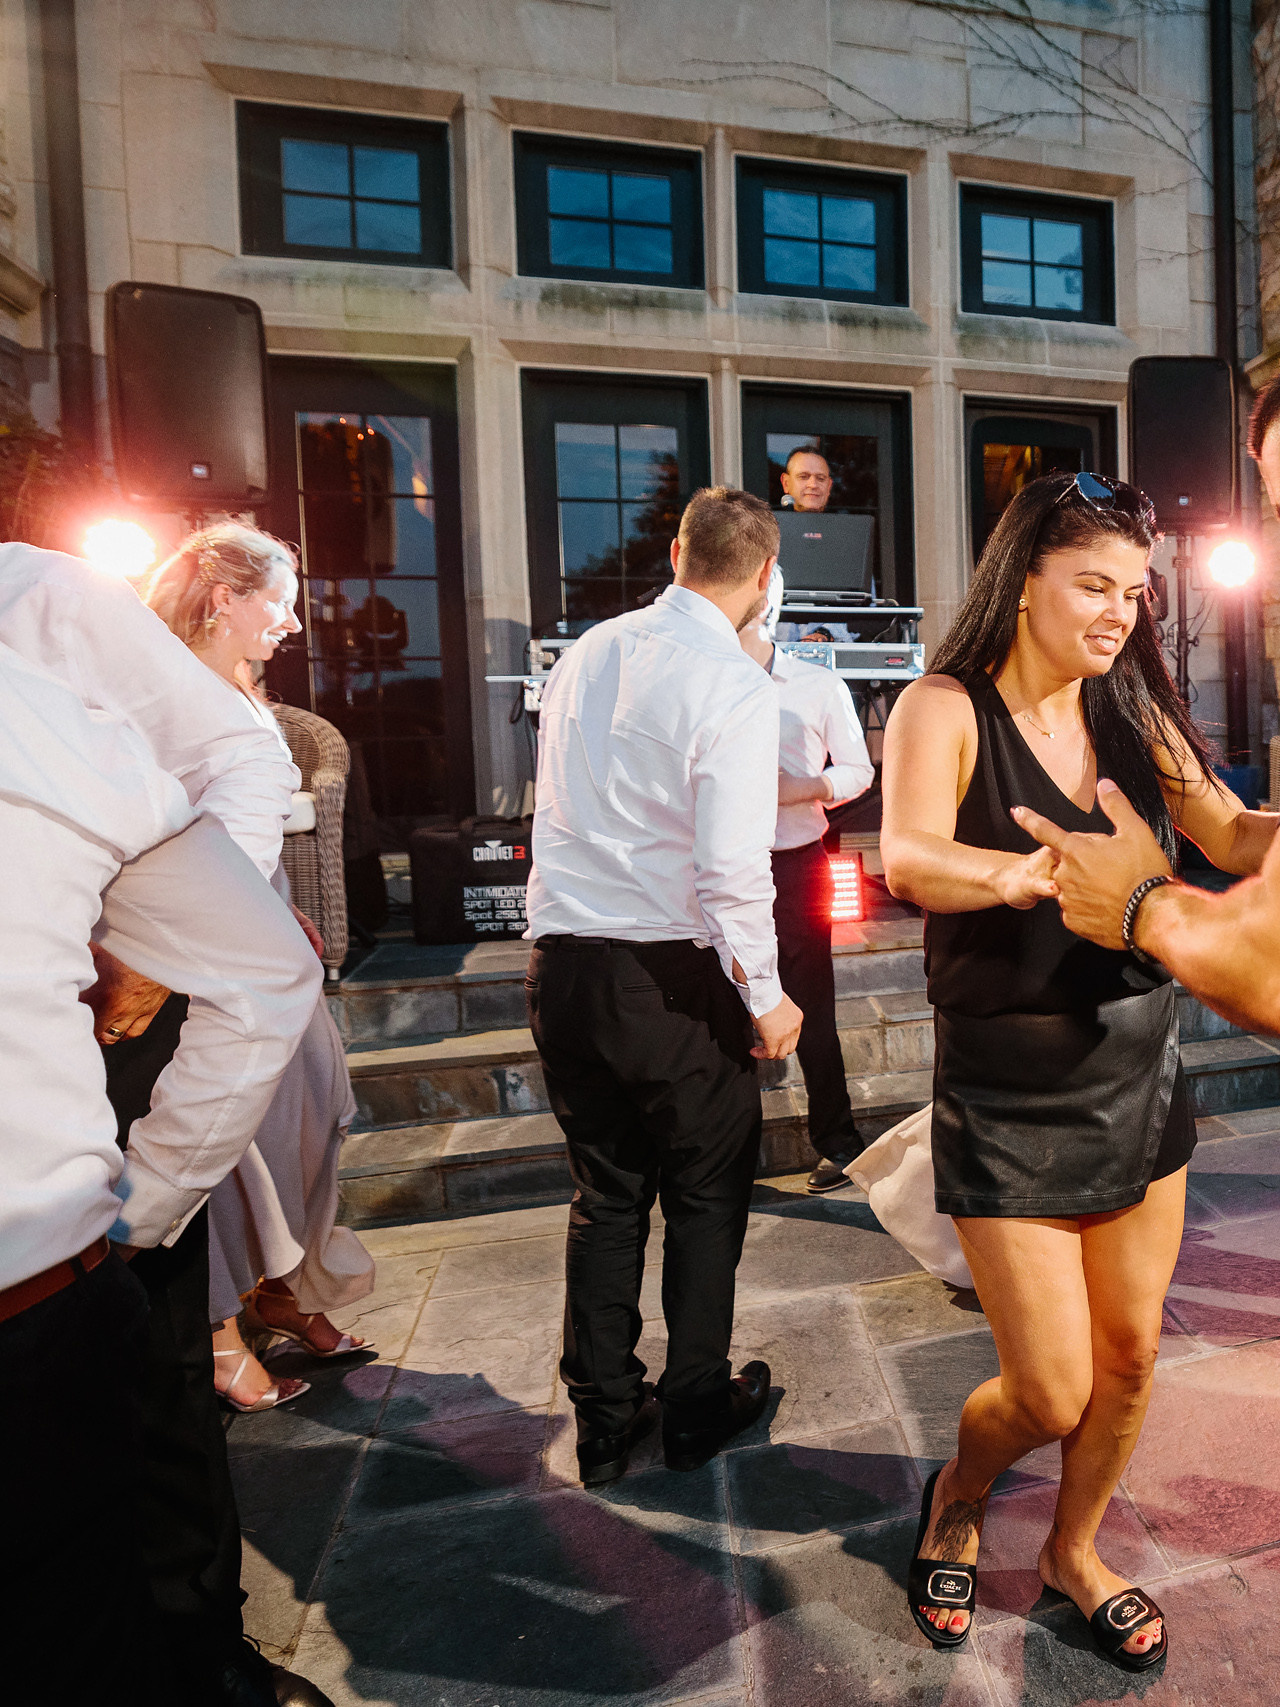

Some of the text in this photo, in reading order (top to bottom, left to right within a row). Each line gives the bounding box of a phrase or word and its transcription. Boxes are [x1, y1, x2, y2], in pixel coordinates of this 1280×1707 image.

[463, 886, 527, 898] INTIMIDATO
[463, 899, 527, 909] SPOT LED 2
[464, 911, 492, 921] Spot
[474, 922, 504, 931] SPOT
